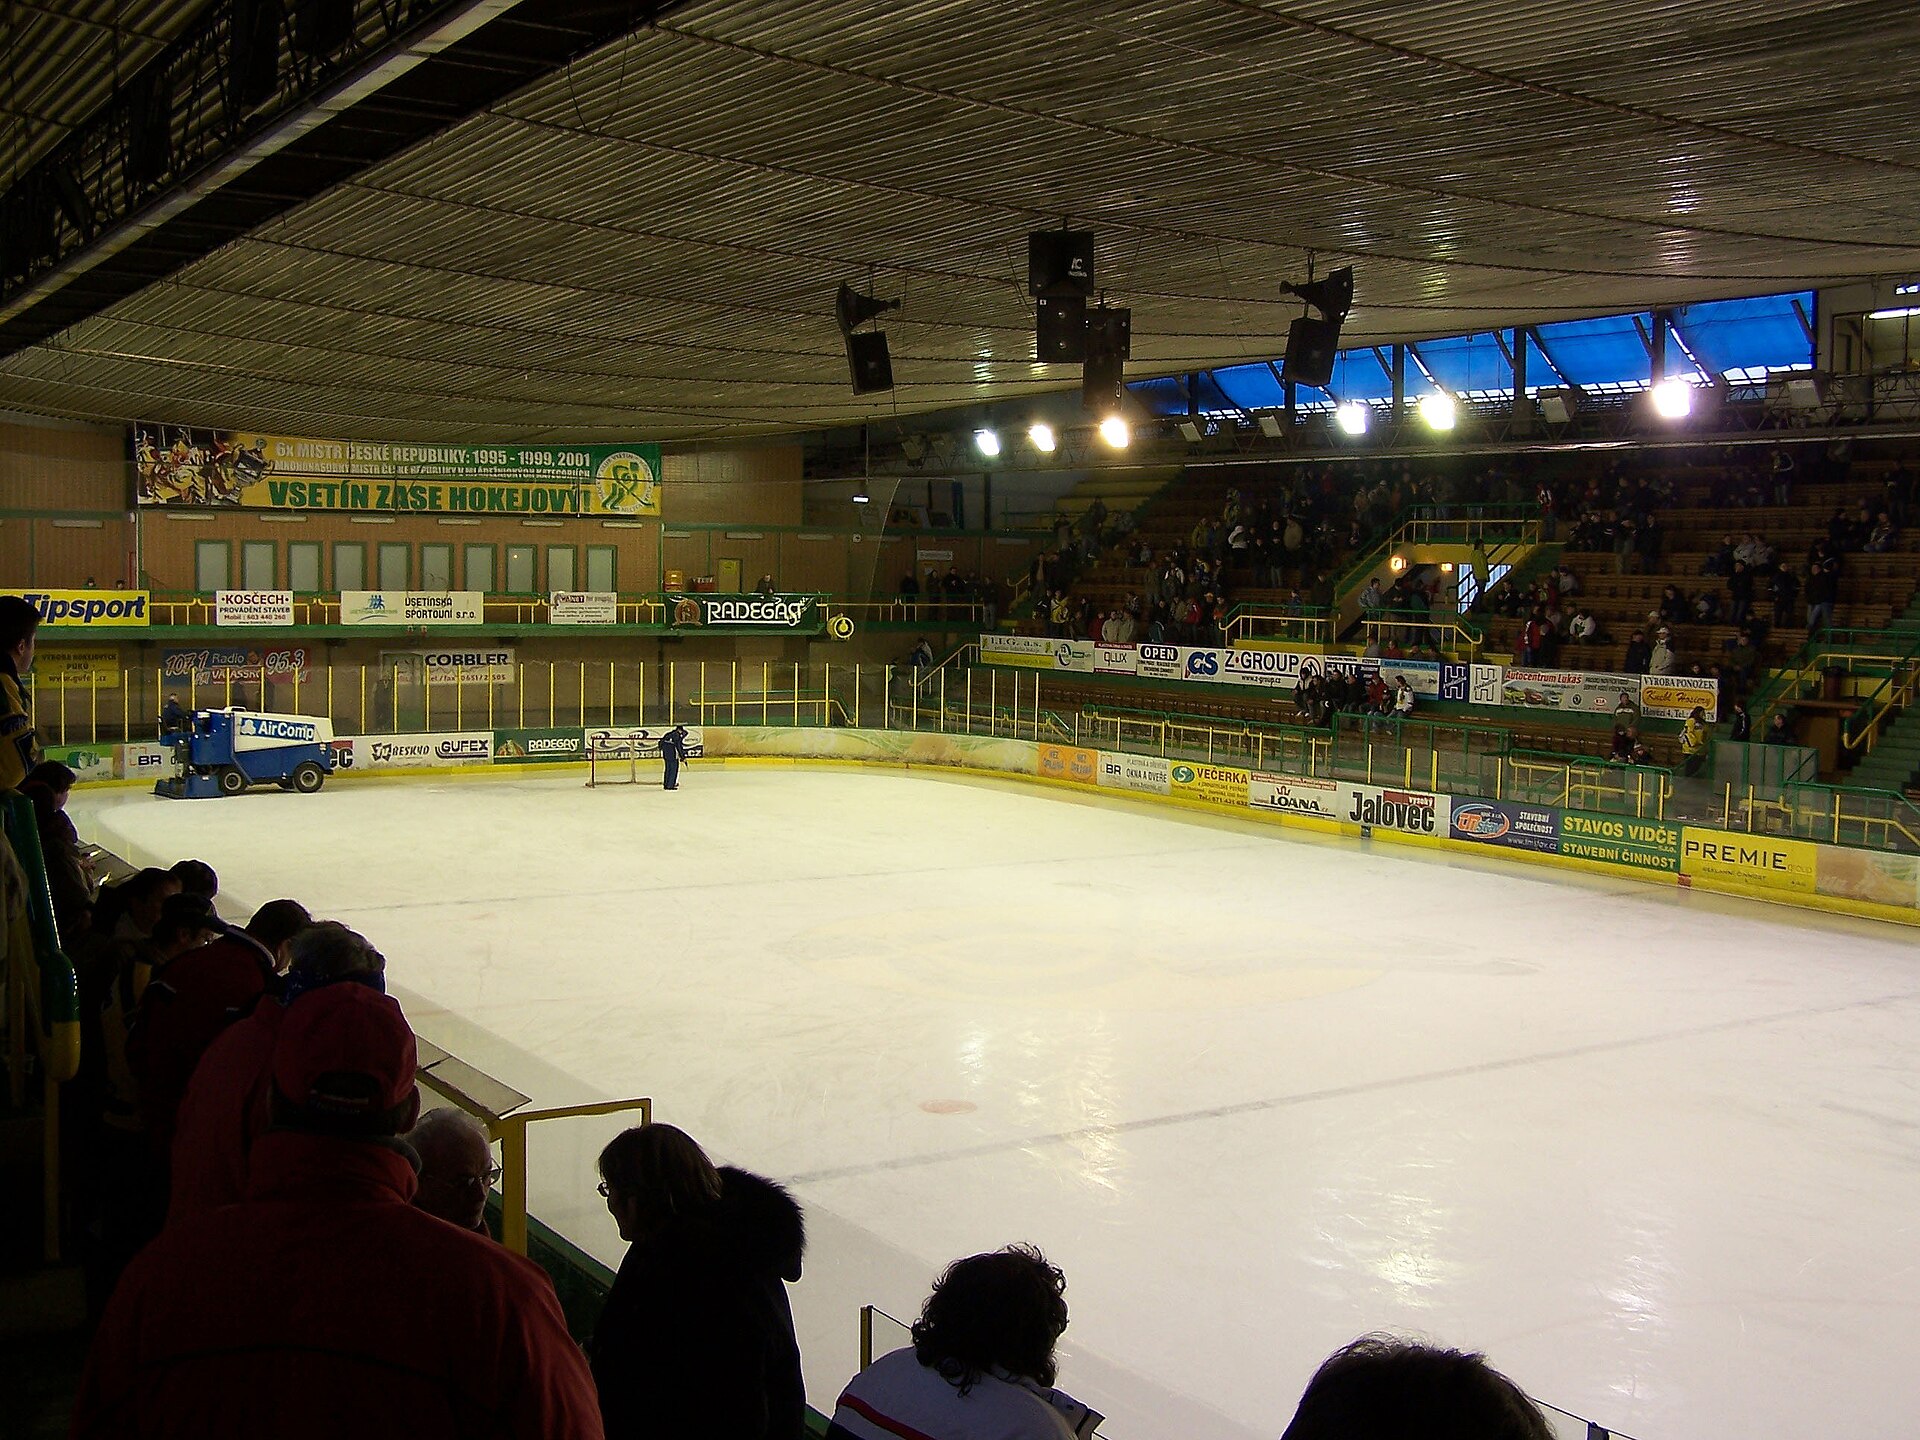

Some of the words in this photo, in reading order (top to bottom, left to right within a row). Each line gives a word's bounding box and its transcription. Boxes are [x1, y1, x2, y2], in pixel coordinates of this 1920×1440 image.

[297, 443, 343, 460] MISTR
[392, 447, 470, 464] REPUBLIKY:
[472, 450, 507, 465] 1995
[518, 451, 556, 467] 1999,
[557, 452, 590, 467] 2001
[268, 480, 369, 509] VSETÍN
[376, 485, 442, 511] ZASE
[225, 591, 285, 605] KOSČECH
[22, 594, 146, 624] Tipsport
[705, 600, 806, 627] RADEGAST
[212, 653, 245, 665] Radio
[425, 653, 508, 667] COBBLER
[1143, 646, 1175, 660] OPEN
[1505, 670, 1557, 683] Autocentrum
[257, 720, 315, 740] AirComp
[441, 739, 489, 752] GUFEX
[528, 738, 580, 752] RADEGAST
[138, 754, 162, 766] BR
[1105, 763, 1121, 776] BR
[1196, 766, 1248, 785] VEČERKA
[1270, 794, 1320, 811] LOANA
[1349, 791, 1435, 832] Jalovec
[1519, 811, 1550, 823] STAVEBNÍ
[1563, 816, 1624, 838] STAVOS
[1628, 824, 1678, 846] VIDČE
[1562, 842, 1620, 860] STAVEBNÍ
[1621, 848, 1677, 869] ČINNOST
[1685, 840, 1787, 870] PREMIE
